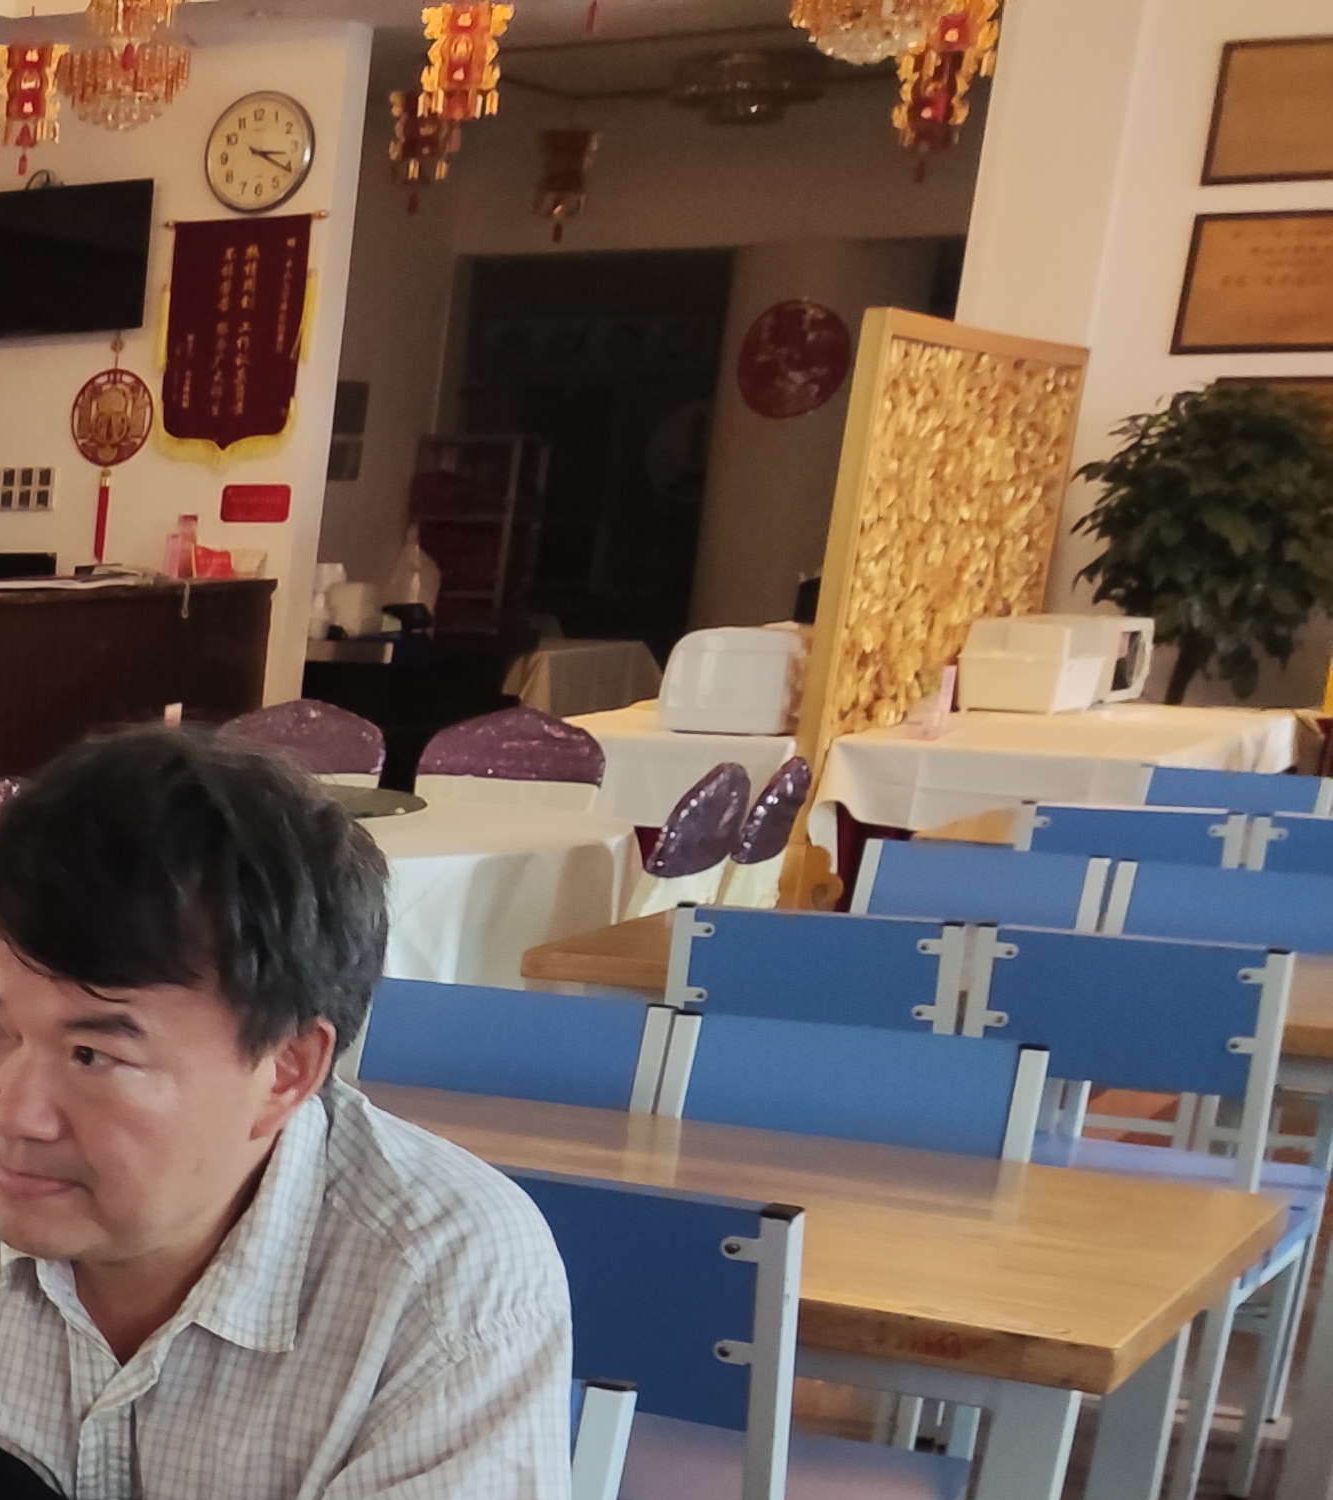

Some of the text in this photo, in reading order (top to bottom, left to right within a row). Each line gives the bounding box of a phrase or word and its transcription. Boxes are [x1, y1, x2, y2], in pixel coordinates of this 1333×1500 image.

[253, 107, 265, 122] 12
[237, 116, 246, 130] 11
[284, 121, 294, 135] 2
[225, 132, 238, 146] 10
[290, 139, 299, 153] 3
[220, 151, 229, 166] 9
[225, 170, 234, 184] 8
[271, 175, 280, 189] 5
[240, 181, 248, 195] 7
[254, 182, 263, 197] 6
